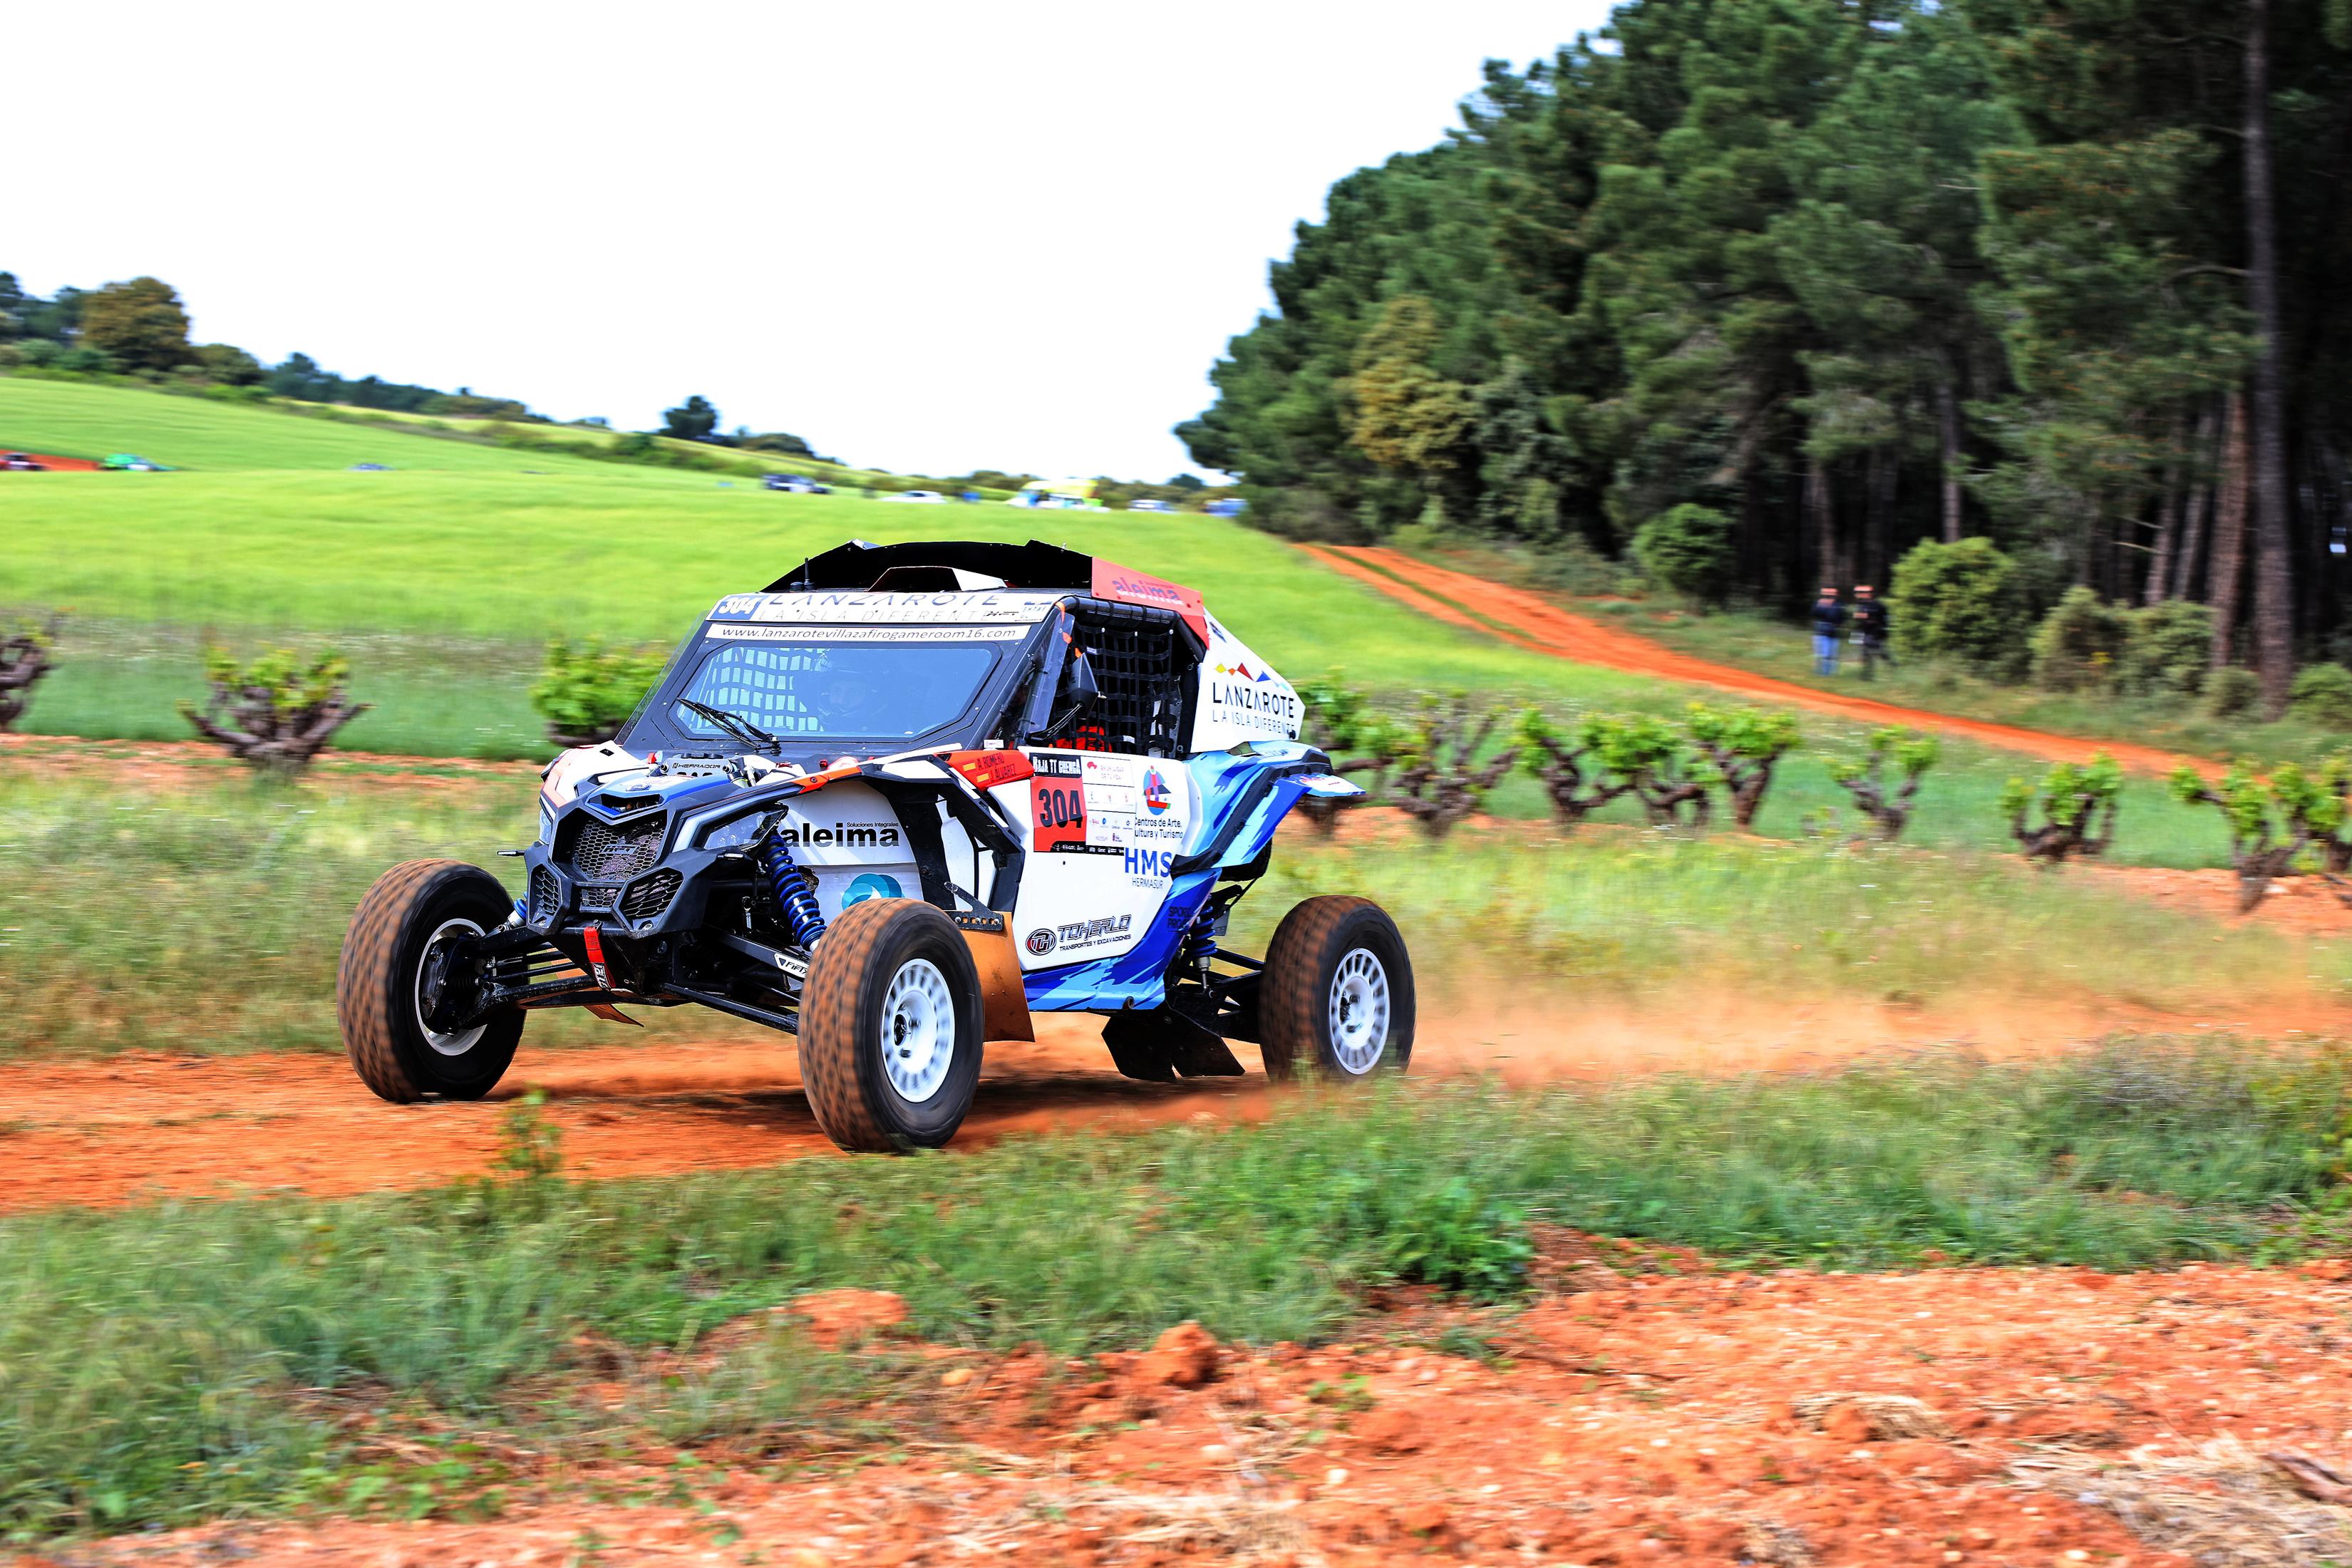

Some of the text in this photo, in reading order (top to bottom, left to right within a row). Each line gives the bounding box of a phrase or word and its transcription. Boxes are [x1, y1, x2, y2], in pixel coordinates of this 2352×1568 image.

[1112, 577, 1184, 605] aleima
[718, 597, 757, 615] 304
[758, 610, 992, 621] LA ISLA DIFERENTE
[722, 627, 1016, 641] www.lanzarotevillazafirogameroom16.com
[1212, 681, 1294, 718] LANZAROTE
[1212, 709, 1294, 736] LA ISLA DIFERENTE
[983, 753, 1004, 770] ROMERO
[1033, 756, 1081, 775] BAJA TT CUENCA
[1038, 788, 1083, 828] 304
[1158, 818, 1166, 827] de
[780, 822, 899, 847] aleima
[1155, 830, 1158, 840] y
[1160, 829, 1183, 839] Turismo
[1125, 847, 1172, 878] HMS
[1132, 877, 1163, 889] HERMASUR
[1058, 914, 1132, 942] TOHERLO
[1059, 941, 1093, 951] TRANSPORTES
[1097, 934, 1132, 945] EXCAVACIONES
